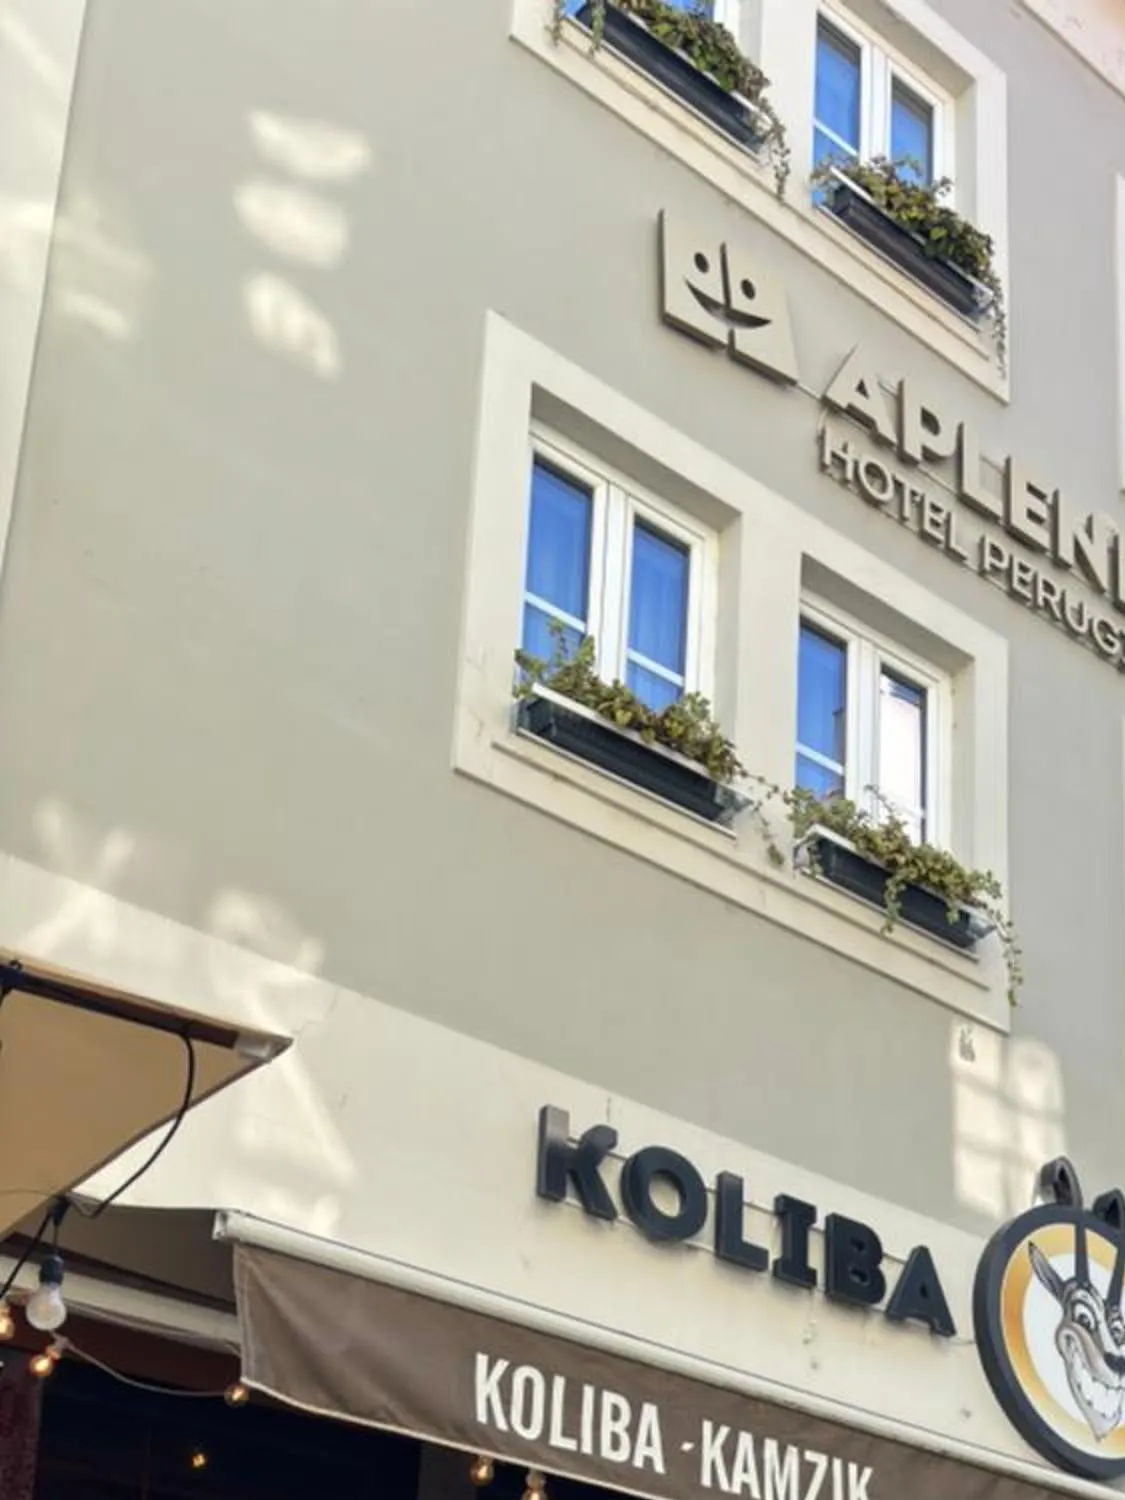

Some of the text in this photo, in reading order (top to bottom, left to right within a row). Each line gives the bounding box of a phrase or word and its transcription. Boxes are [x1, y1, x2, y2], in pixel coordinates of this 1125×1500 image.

[819, 426, 970, 565] HOTEL
[536, 1103, 957, 1338] KOLIBA
[474, 1351, 667, 1475] KOLIBA
